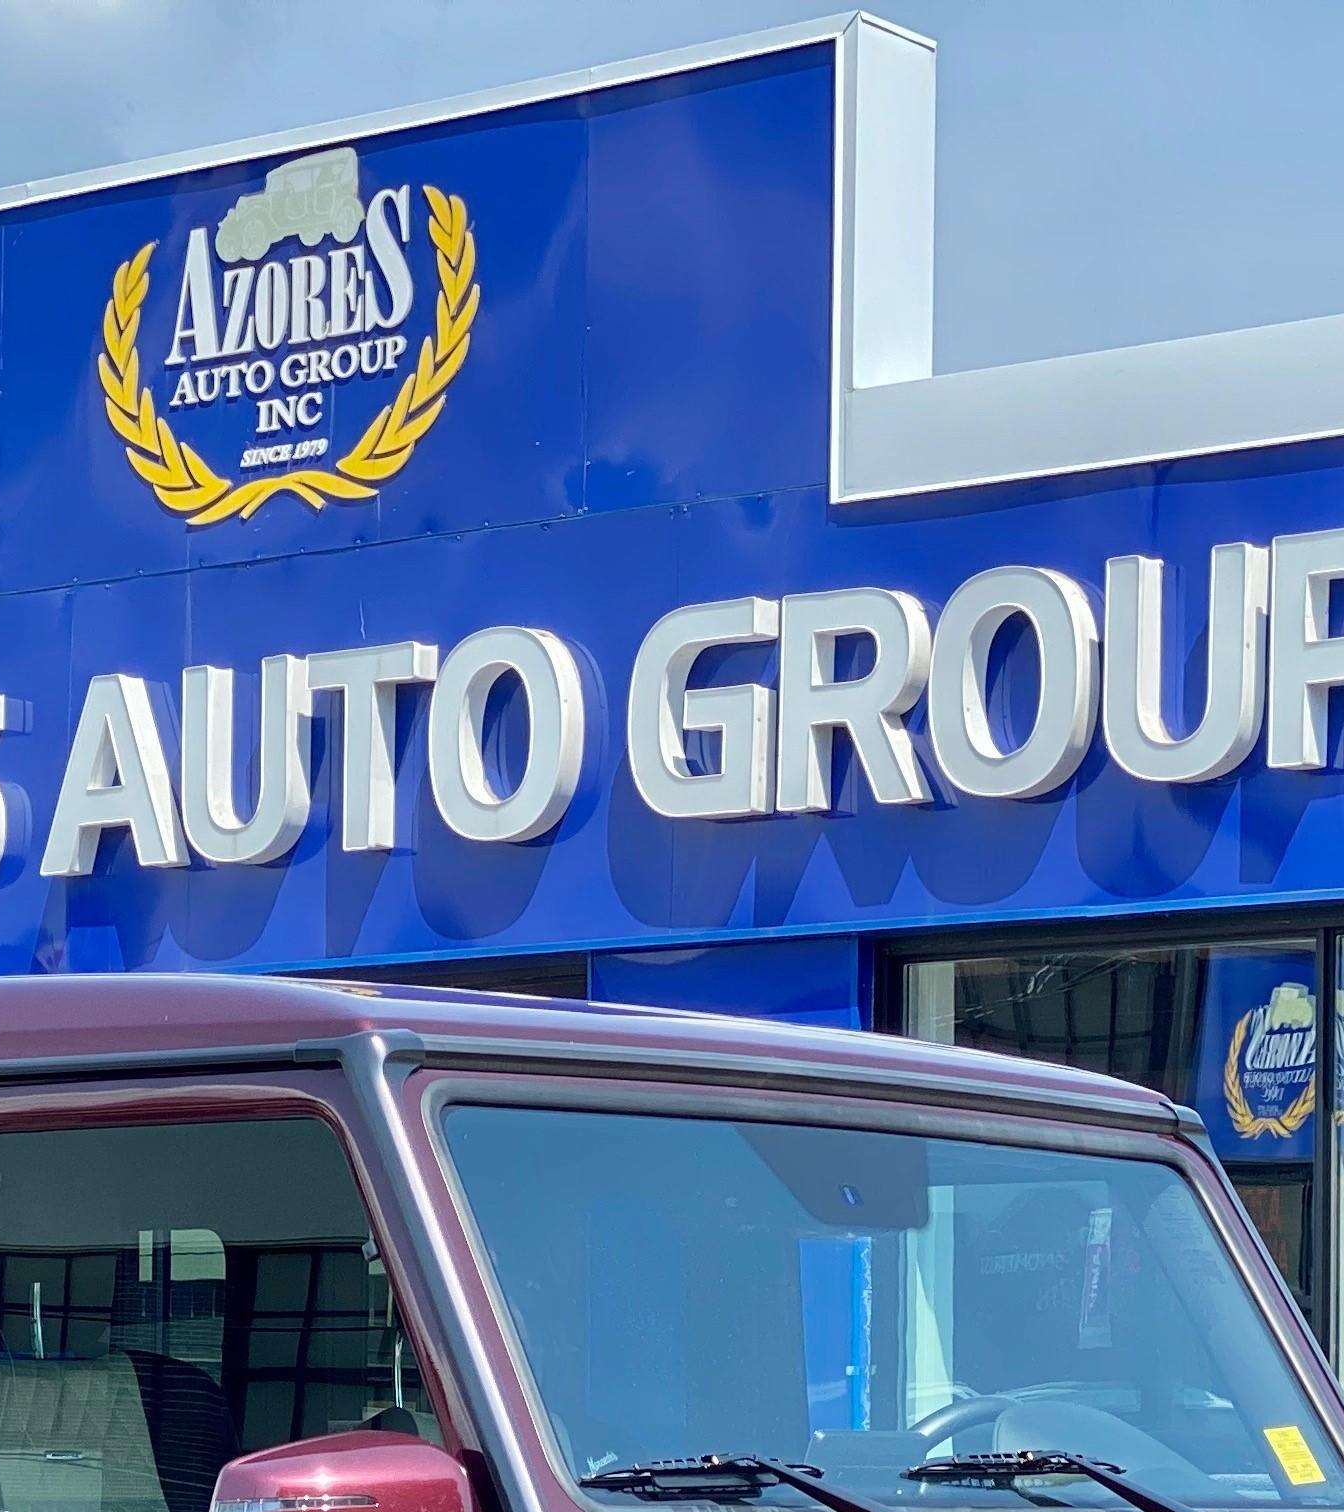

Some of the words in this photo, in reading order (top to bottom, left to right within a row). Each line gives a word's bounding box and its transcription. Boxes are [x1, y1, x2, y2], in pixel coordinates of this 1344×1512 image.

[164, 184, 413, 366] AZORES
[169, 359, 274, 407] AUTO
[280, 336, 408, 388] GROUP
[255, 392, 323, 433] INC
[240, 443, 293, 467] SINCE
[292, 437, 329, 459] 1979
[39, 626, 585, 877] AUTO
